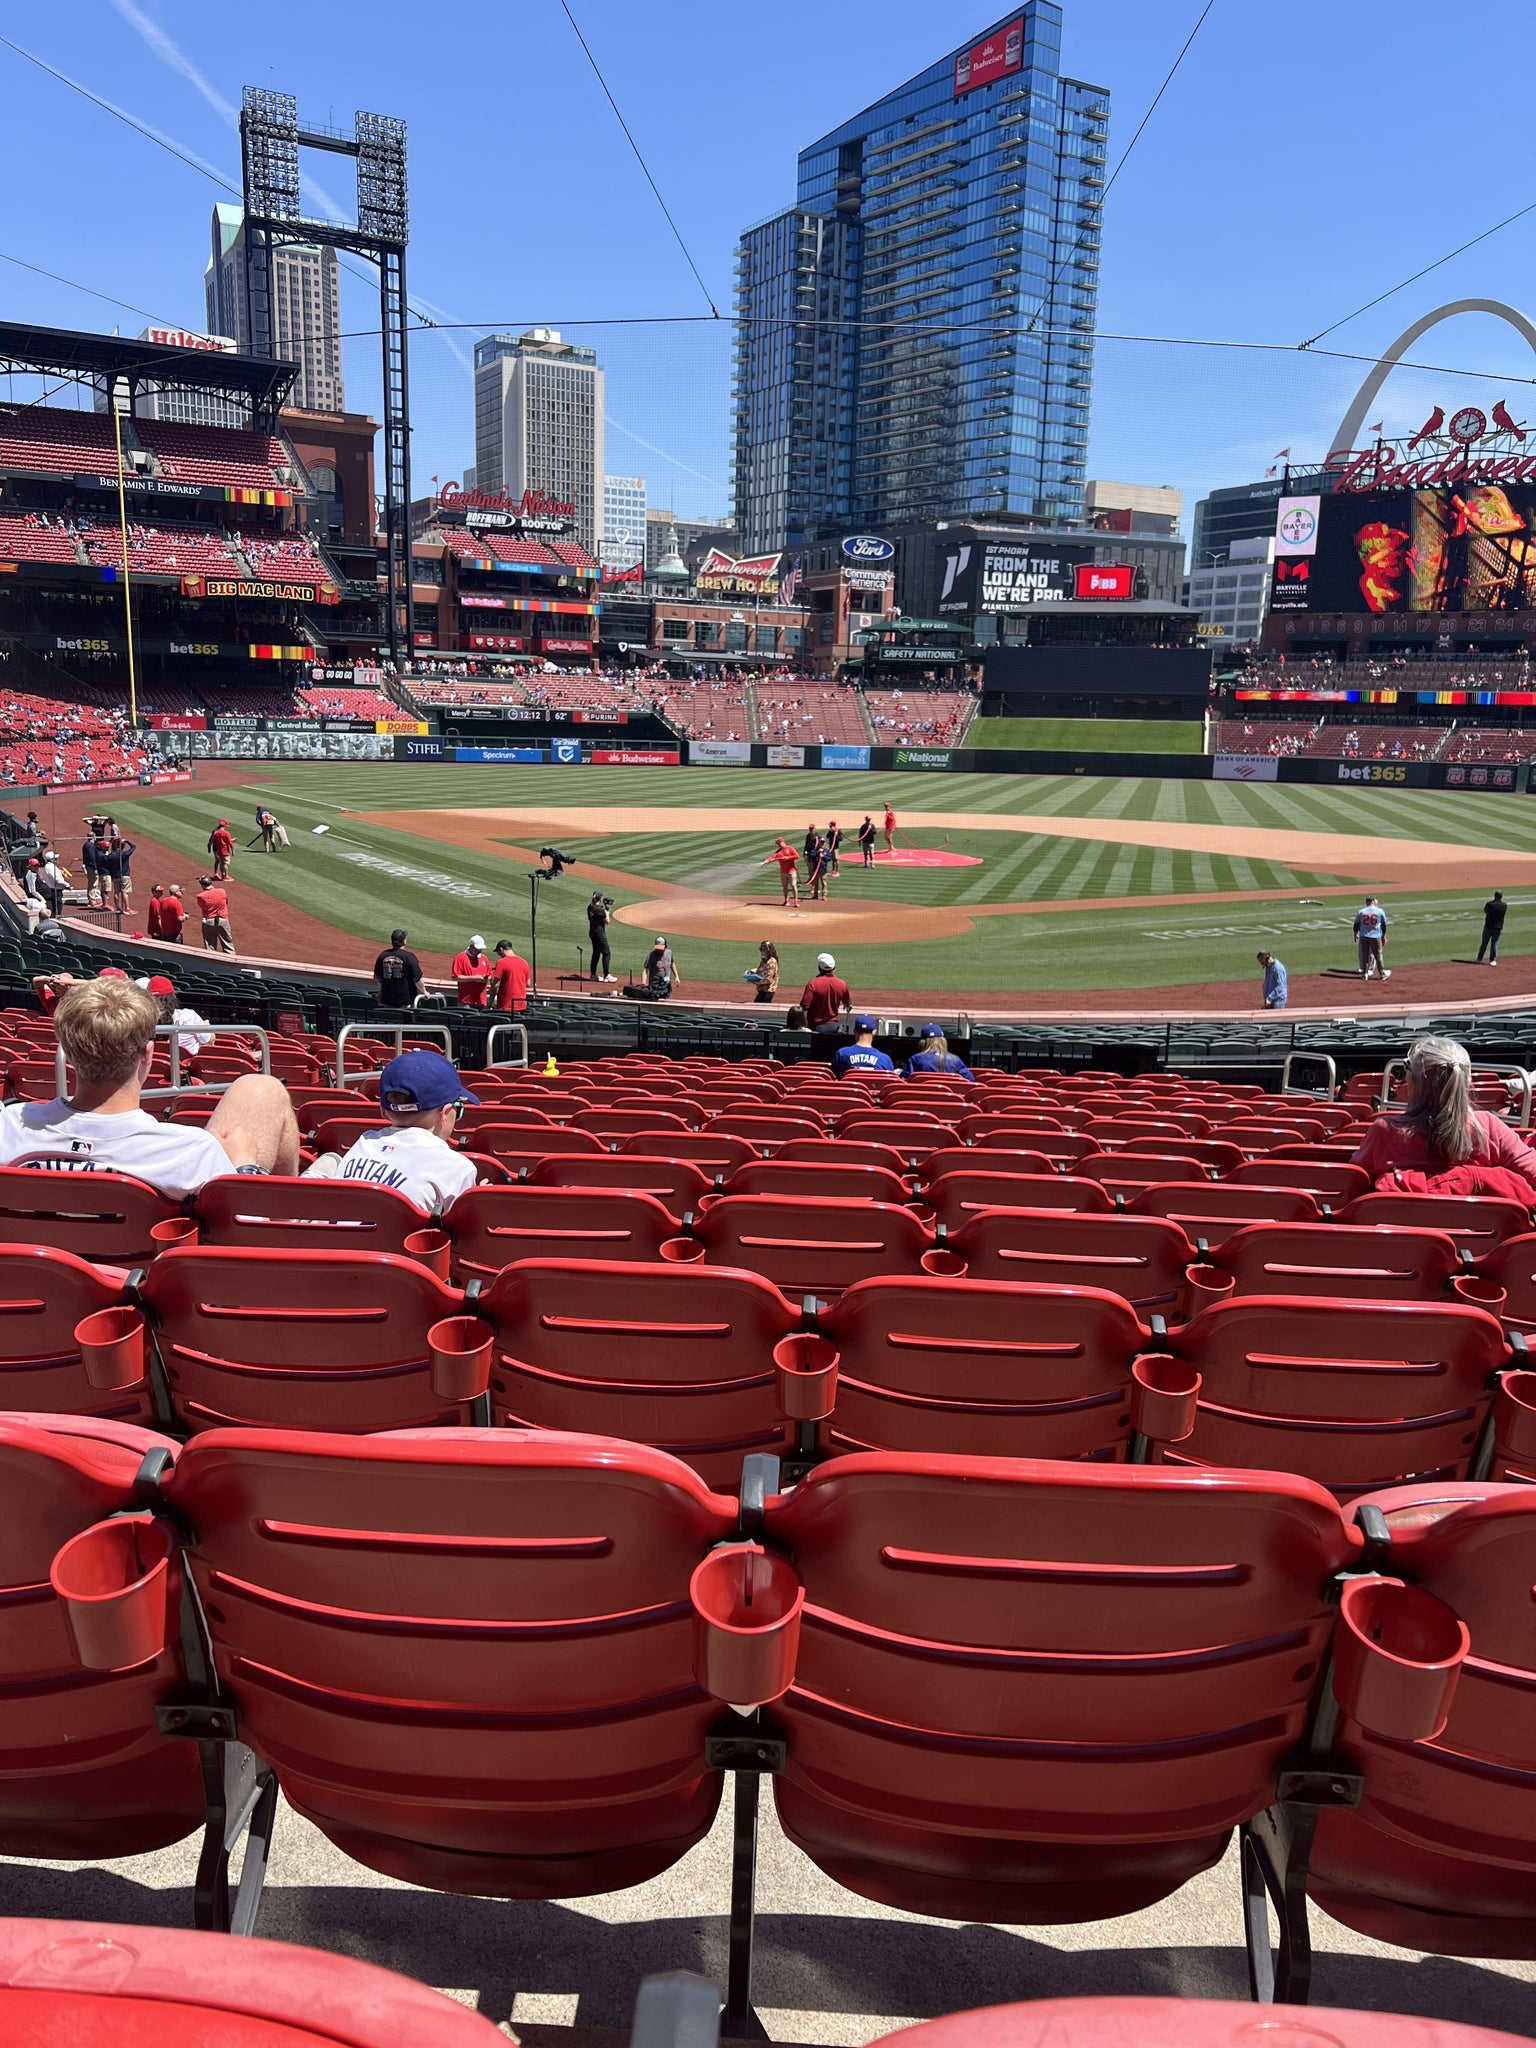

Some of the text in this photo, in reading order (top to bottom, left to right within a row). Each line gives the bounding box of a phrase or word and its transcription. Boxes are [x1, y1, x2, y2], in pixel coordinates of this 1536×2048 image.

[973, 54, 1004, 71] Budweiser
[99, 477, 146, 490] BENAMIN
[147, 481, 155, 491] F.
[441, 481, 575, 516] Cardinals Nation
[466, 512, 507, 525] HOFFMANN
[521, 519, 564, 531] ROOFTOP
[1293, 511, 1302, 541] BAYER
[853, 539, 885, 556] Ford
[999, 546, 1029, 556] PHORM
[697, 556, 779, 577] Budweiser
[984, 556, 1060, 574] FROM THE
[603, 563, 643, 584] Live!
[844, 568, 892, 582] Community
[983, 571, 1049, 588] LOU AND
[207, 581, 315, 602] BIG MAC LAND
[696, 576, 779, 594] BREW HOUSE
[982, 586, 1073, 602] WE'RE PRO
[1272, 602, 1308, 610] maryville.edu
[1193, 624, 1225, 635] OKE
[1320, 620, 1331, 633] 2
[1353, 620, 1363, 634] 9
[1371, 620, 1385, 633] 10
[1393, 620, 1408, 633] 14
[1416, 619, 1431, 632] 17
[1439, 619, 1457, 633] 20
[1467, 619, 1487, 633] 23
[1494, 618, 1514, 632] 24
[57, 637, 109, 651] bet365
[170, 642, 219, 655] bet365
[883, 649, 956, 659] SAFETY NATIONAL
[326, 670, 352, 679] GO GO GO
[451, 710, 467, 718] Mercy
[519, 711, 541, 719] 12:12
[590, 713, 617, 721] PURINA
[215, 718, 257, 726] ROTTLER
[277, 721, 320, 730] Central Bank
[387, 722, 419, 731] DOBBS
[407, 742, 442, 755] STIFEL
[552, 738, 579, 746] CarShield
[482, 751, 514, 760] Spectrum
[622, 754, 665, 764] Budweiser
[909, 752, 949, 763] National
[1337, 764, 1406, 782] bet365
[1362, 914, 1378, 925] 26
[849, 1053, 878, 1066] OHTANI
[343, 1158, 408, 1188] OHTANI
